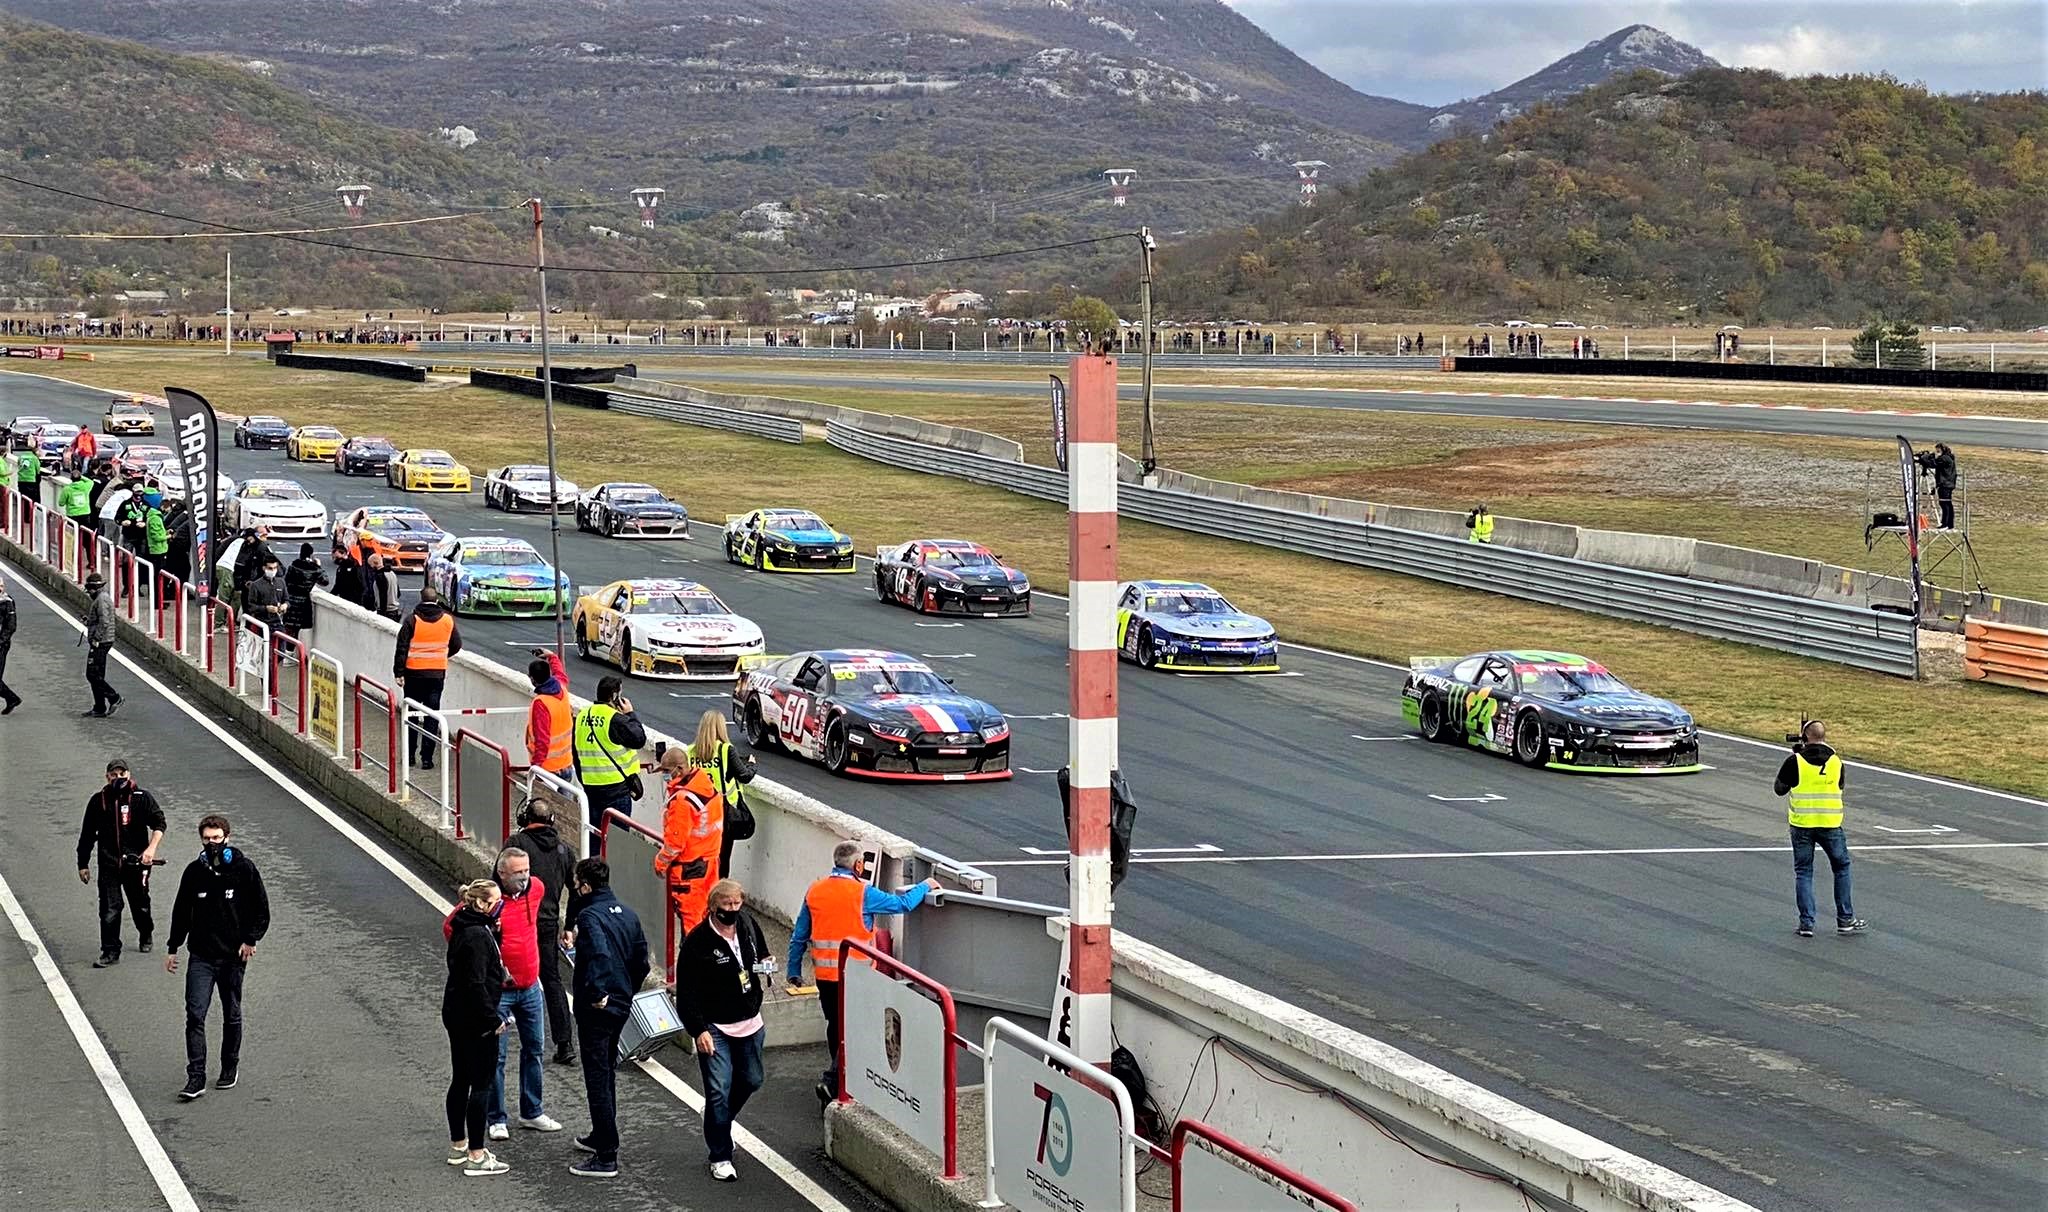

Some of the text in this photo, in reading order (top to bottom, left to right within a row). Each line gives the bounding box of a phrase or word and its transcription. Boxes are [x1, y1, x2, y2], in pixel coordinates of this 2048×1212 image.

[895, 567, 908, 594] 18
[833, 671, 857, 680] 50
[1423, 673, 1453, 691] HEINZ
[580, 715, 606, 728] PRESS
[781, 693, 808, 738] 50
[1466, 694, 1497, 734] 24
[586, 732, 595, 744] 4
[690, 757, 720, 768] PRESS
[1563, 750, 1574, 760] 24
[866, 1067, 921, 1114] PORSCHE
[1033, 1081, 1073, 1178] 70
[1026, 1167, 1085, 1212] PORSCHE
